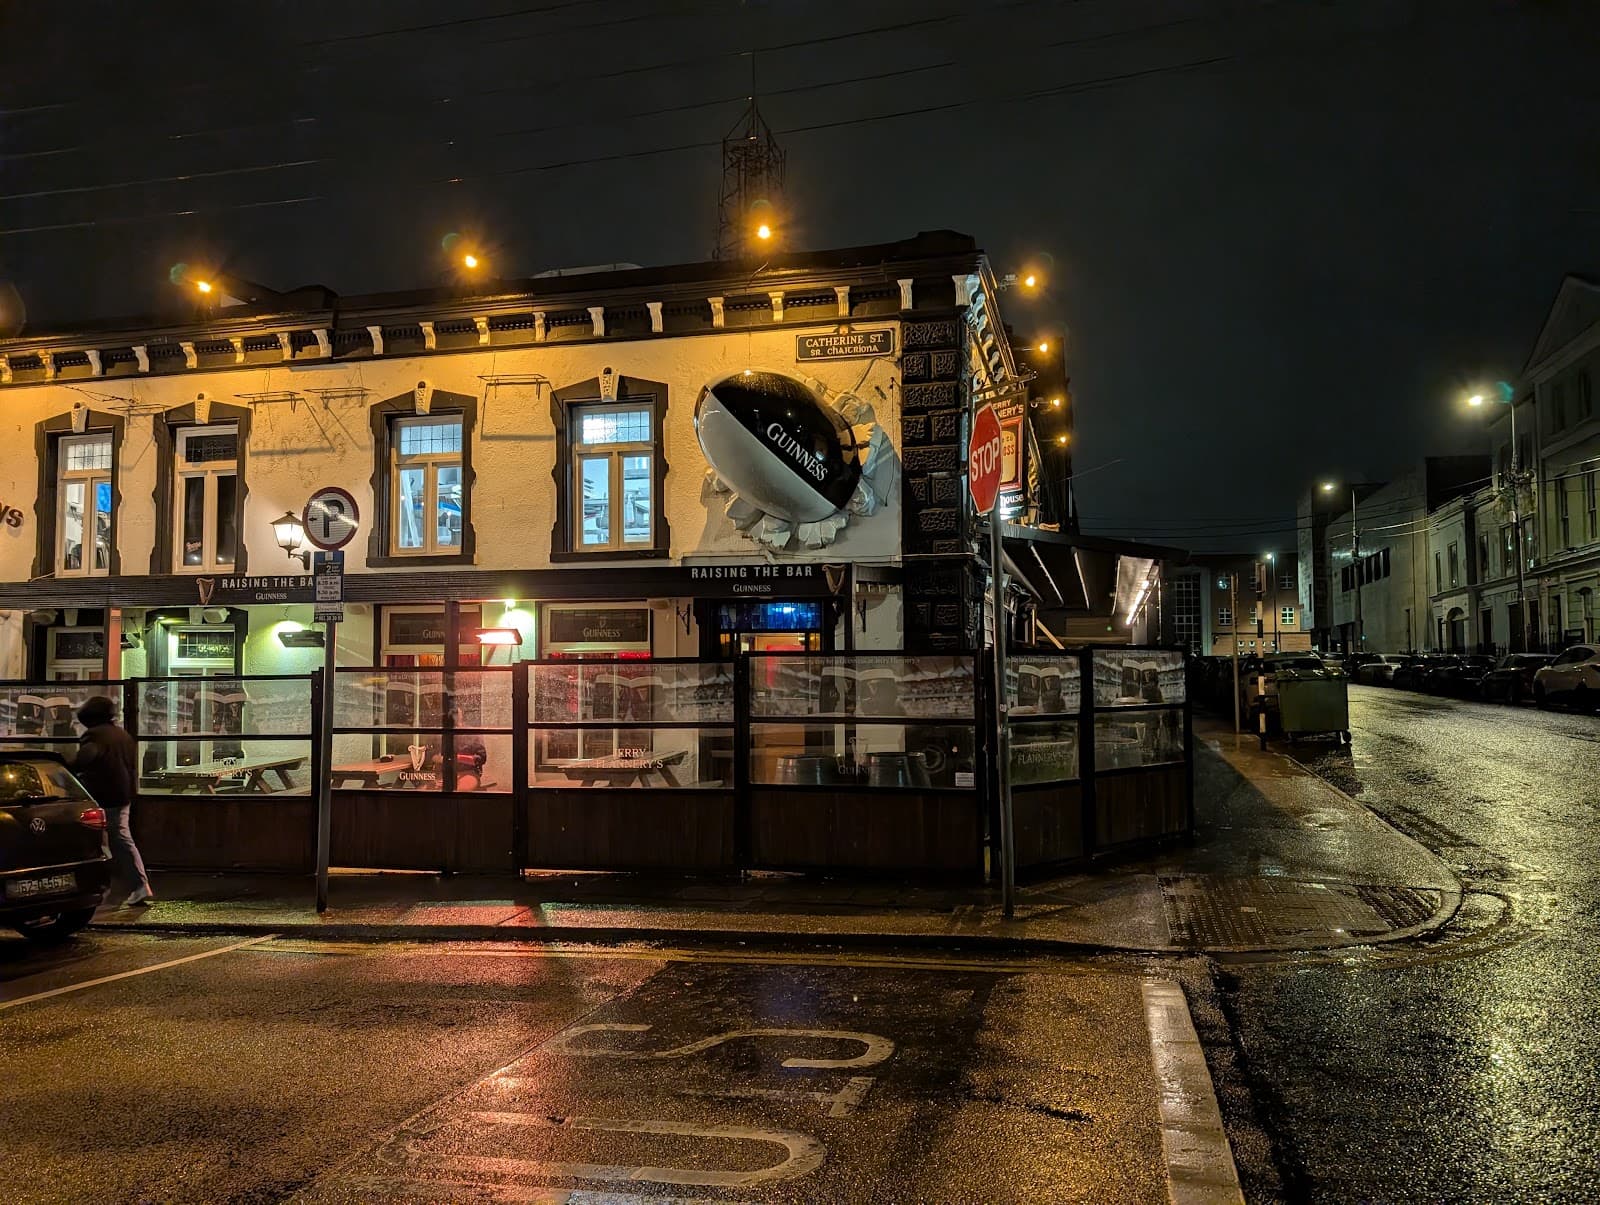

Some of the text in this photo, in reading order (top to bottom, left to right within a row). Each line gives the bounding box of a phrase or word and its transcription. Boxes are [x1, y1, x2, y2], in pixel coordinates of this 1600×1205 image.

[805, 335, 864, 348] CATHERINE
[992, 398, 1012, 410] ERRY
[997, 403, 1024, 418] NERY'S
[766, 422, 829, 481] GUINNESS
[971, 436, 1000, 483] STOP
[691, 565, 813, 579] RAISING THE BAR
[222, 577, 269, 589] RAISING
[273, 576, 294, 588] THE
[299, 576, 315, 588] BA
[732, 583, 772, 594] GUINNESS
[255, 592, 288, 601] GUINNESS
[582, 626, 622, 638] GUINNESS
[399, 771, 436, 781] GUINNESS
